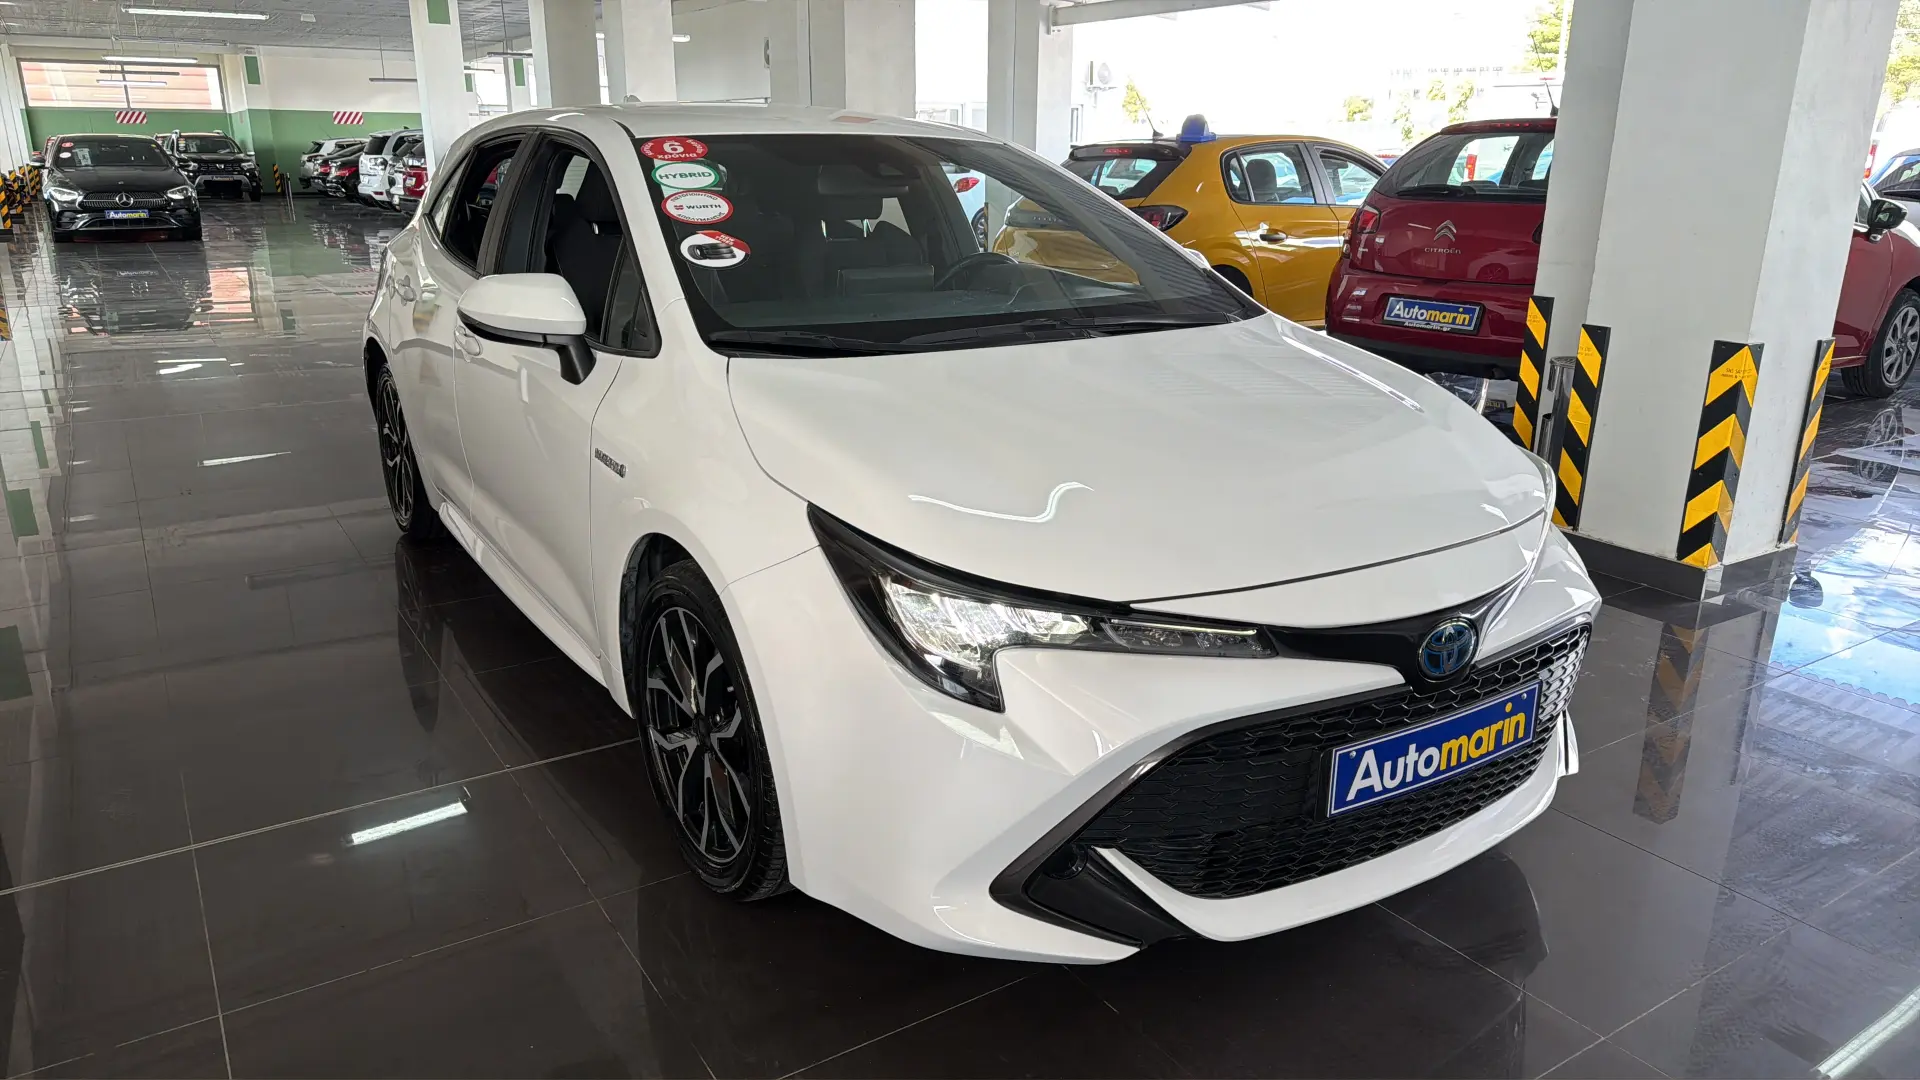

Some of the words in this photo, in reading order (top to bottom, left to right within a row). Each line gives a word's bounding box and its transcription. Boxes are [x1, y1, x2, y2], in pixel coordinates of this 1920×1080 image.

[663, 142, 684, 154] 6
[659, 171, 712, 180] HYBRID
[109, 210, 147, 219] Automarin
[721, 233, 736, 242] NEW
[1391, 301, 1470, 325] Automarin
[1404, 321, 1451, 331] Automarin.gr
[1346, 702, 1526, 802] Automarin
